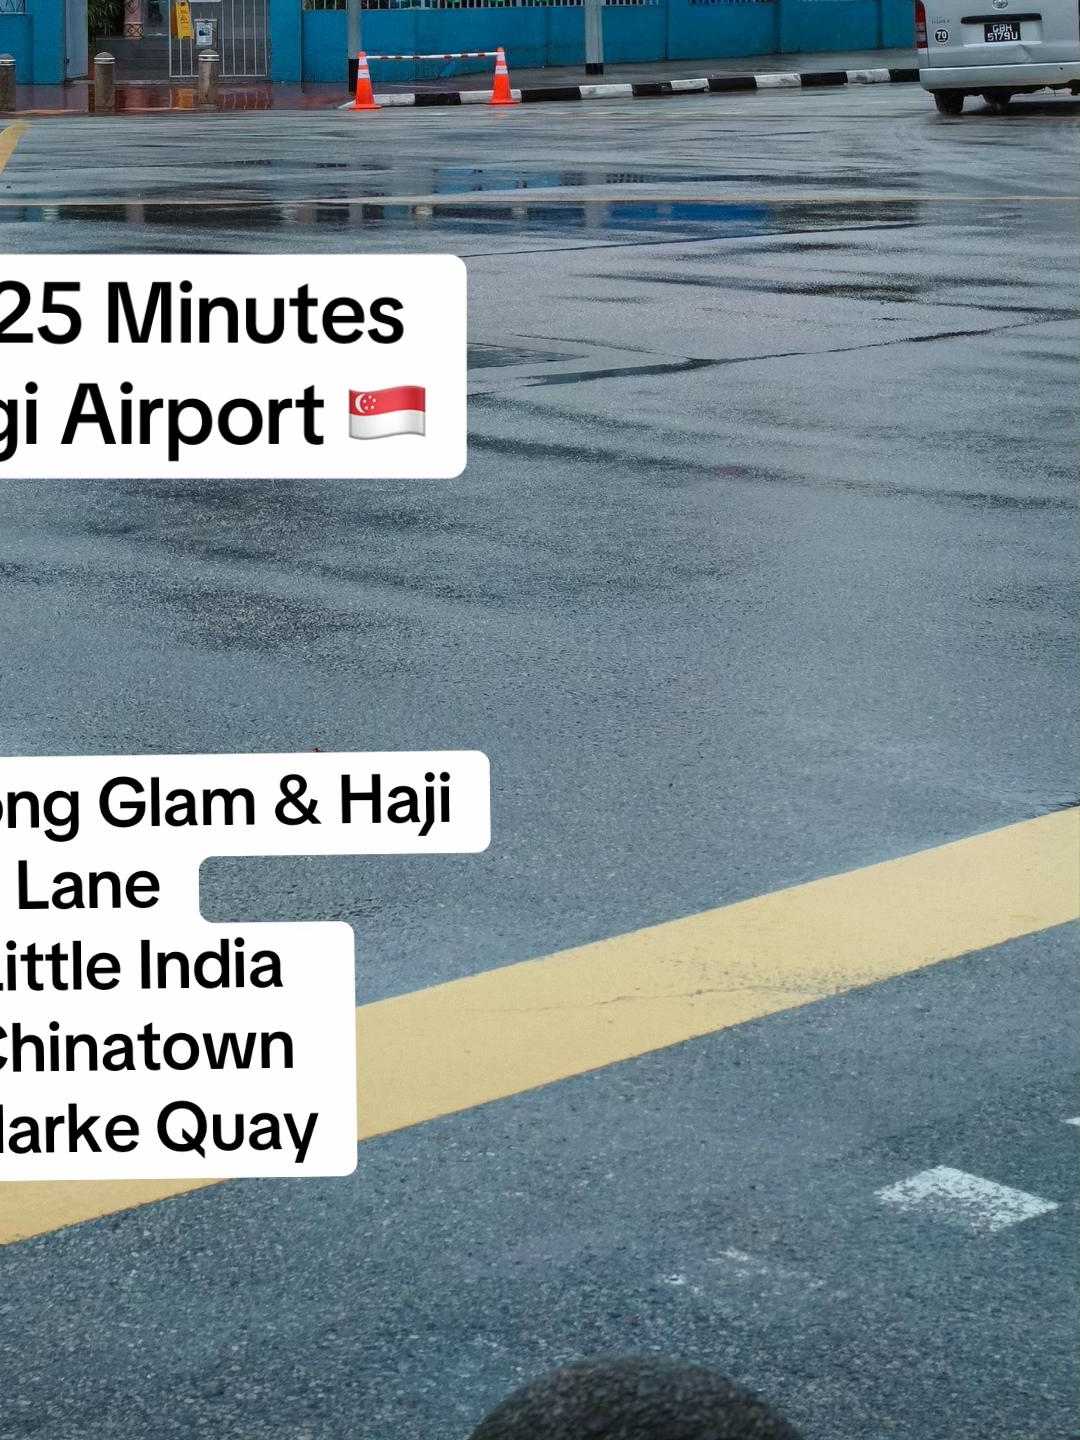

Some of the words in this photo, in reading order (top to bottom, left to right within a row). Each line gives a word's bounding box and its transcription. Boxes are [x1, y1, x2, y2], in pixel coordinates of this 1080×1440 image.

[992, 24, 1012, 32] GBH
[936, 31, 947, 39] 70
[987, 32, 1018, 41] 5179U
